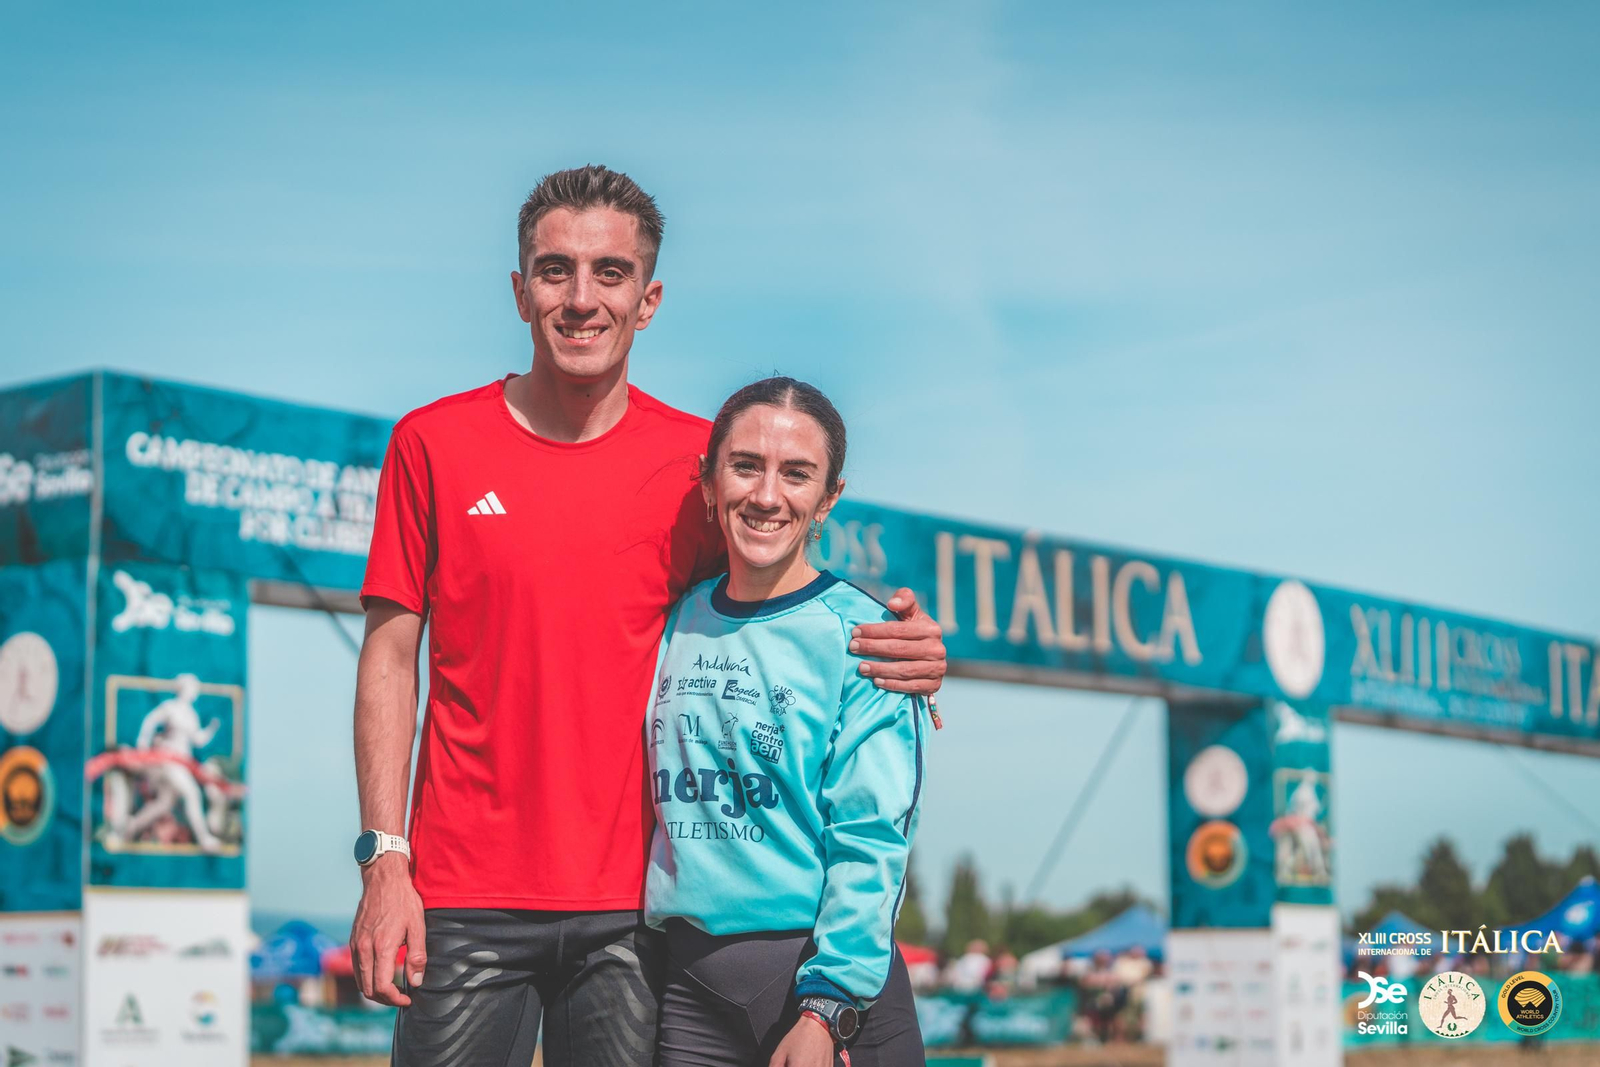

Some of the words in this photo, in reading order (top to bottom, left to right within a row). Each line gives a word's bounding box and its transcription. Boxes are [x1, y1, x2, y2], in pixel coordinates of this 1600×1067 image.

[934, 530, 1201, 665] ITÁLICA
[689, 676, 716, 689] activa
[755, 721, 779, 736] nerja
[653, 758, 779, 819] nerja
